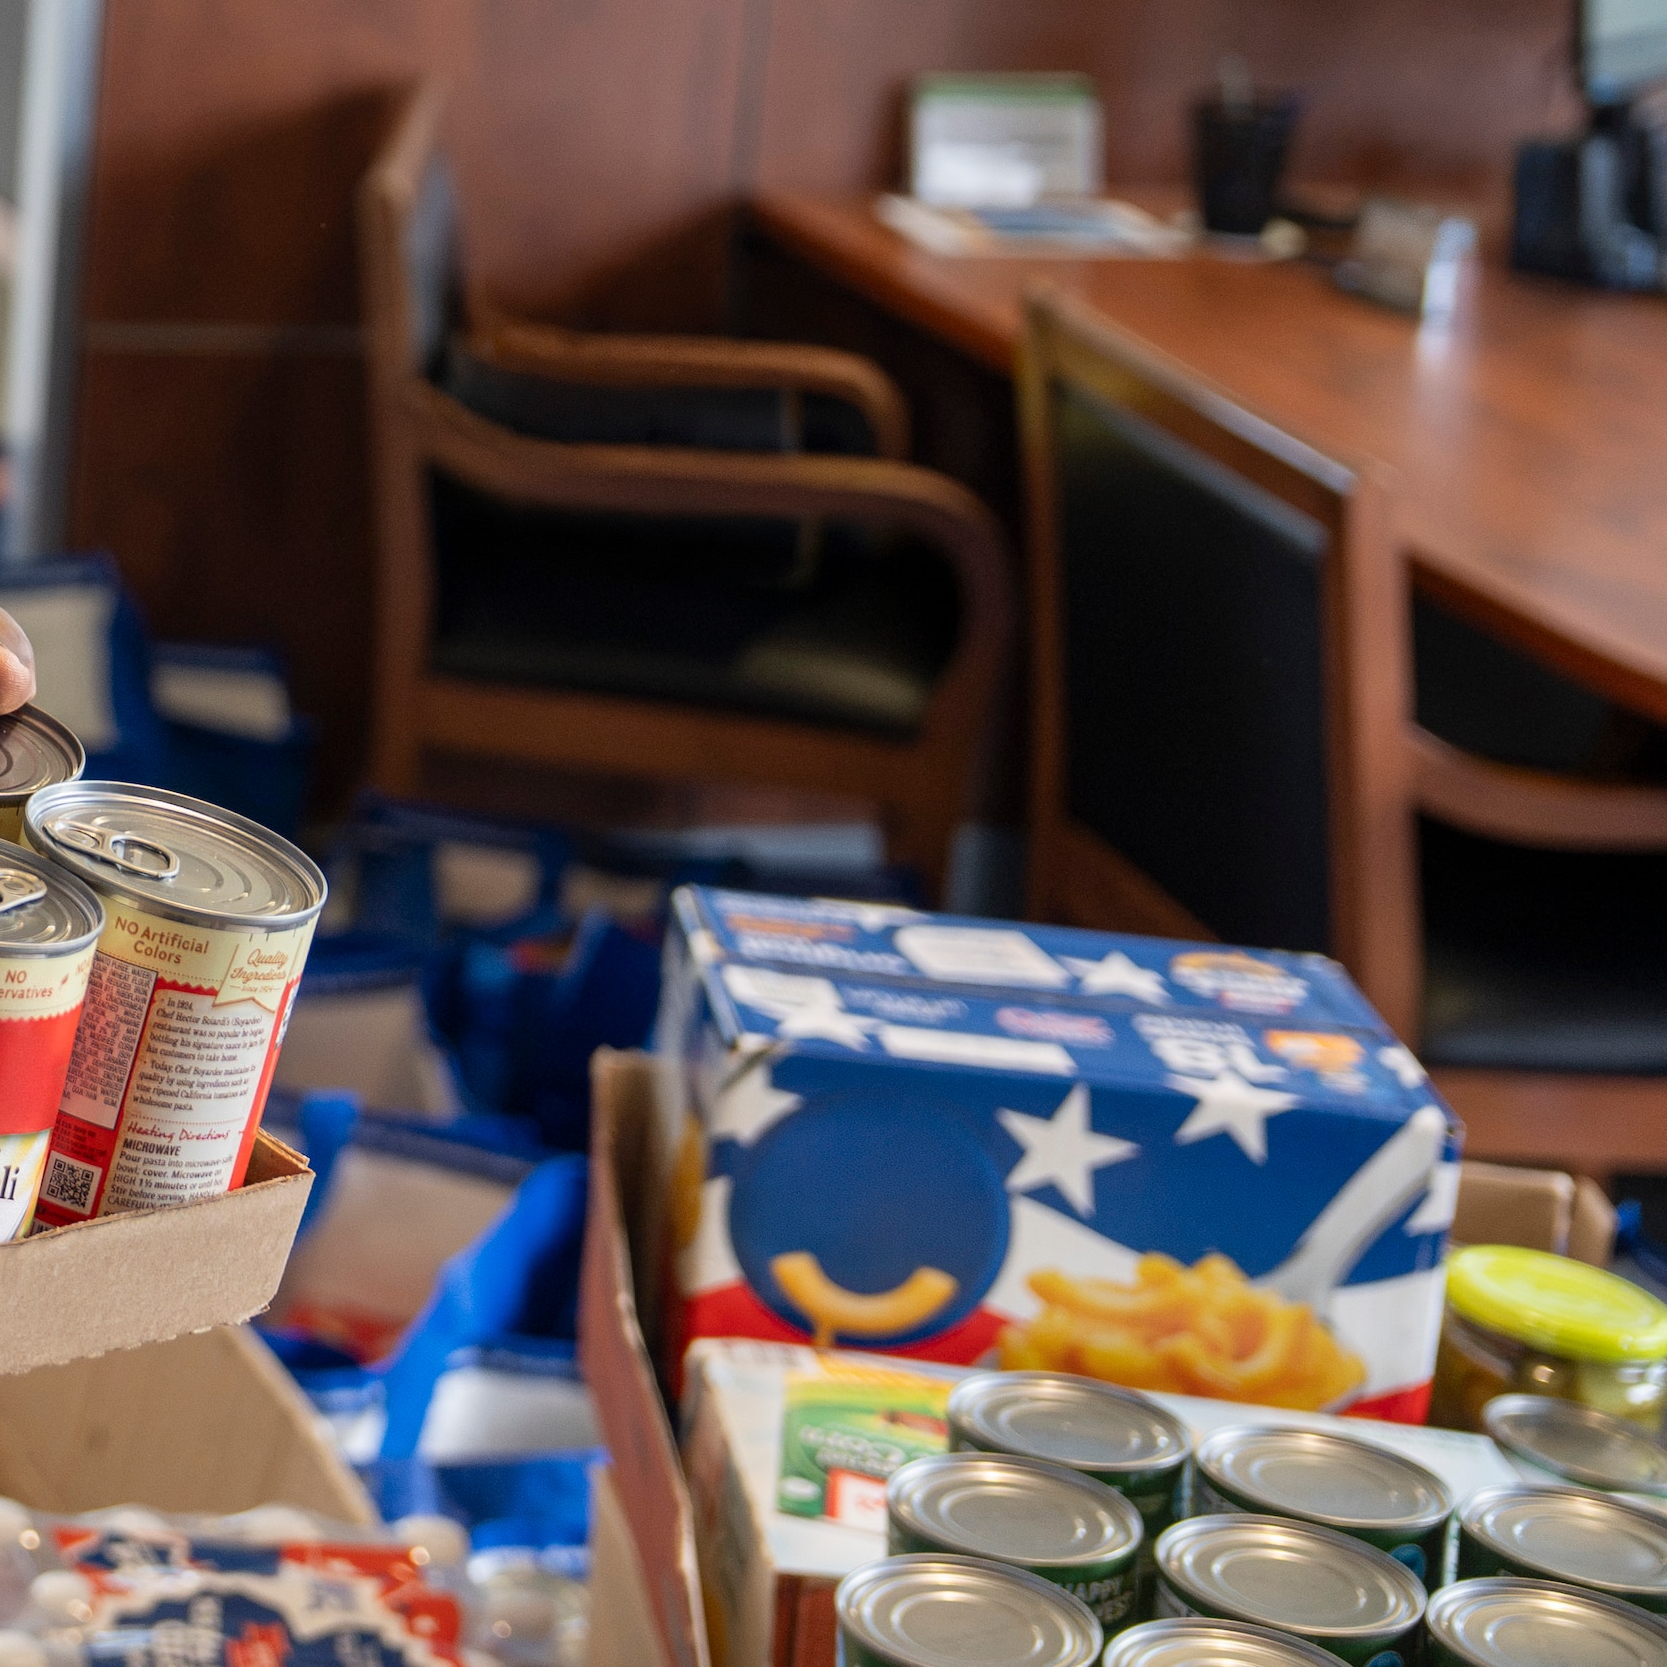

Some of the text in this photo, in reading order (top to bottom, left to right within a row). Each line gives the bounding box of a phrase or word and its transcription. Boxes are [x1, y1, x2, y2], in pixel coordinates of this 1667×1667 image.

[115, 916, 210, 955] NO Artificial
[133, 940, 183, 965] Colors
[247, 948, 289, 970] Quality
[5, 970, 27, 984] NO
[156, 1008, 175, 1020] Chef
[176, 1012, 200, 1025] Hector
[153, 1021, 192, 1036] restaurant
[193, 1028, 206, 1037] was
[208, 1030, 216, 1038] so
[150, 1032, 178, 1047] bottling
[180, 1037, 191, 1048] his
[192, 1040, 223, 1051] signature
[146, 1042, 158, 1054] his
[160, 1047, 195, 1061] customers
[197, 1051, 204, 1061] to
[206, 1051, 220, 1062] take
[151, 1059, 173, 1074] Today,
[175, 1064, 192, 1075] Chef
[193, 1067, 222, 1078] Boyardee
[139, 1071, 165, 1085] quality
[166, 1075, 175, 1086] by
[176, 1078, 195, 1090] using
[196, 1080, 230, 1090] ingredients
[153, 1085, 179, 1099] ripened
[181, 1089, 212, 1100] California
[133, 1095, 173, 1110] wholesome
[128, 1121, 175, 1143] Heating
[179, 1128, 230, 1142] Directions
[123, 1137, 182, 1157] MICROWAVE
[119, 1150, 142, 1164] Pour
[143, 1156, 167, 1168] pasta
[168, 1157, 184, 1168] into
[113, 1173, 137, 1186] HIGH
[154, 1180, 188, 1191] minutes
[171, 1169, 213, 1180] Microwave
[110, 1184, 126, 1196] Stir
[129, 1187, 156, 1201] before
